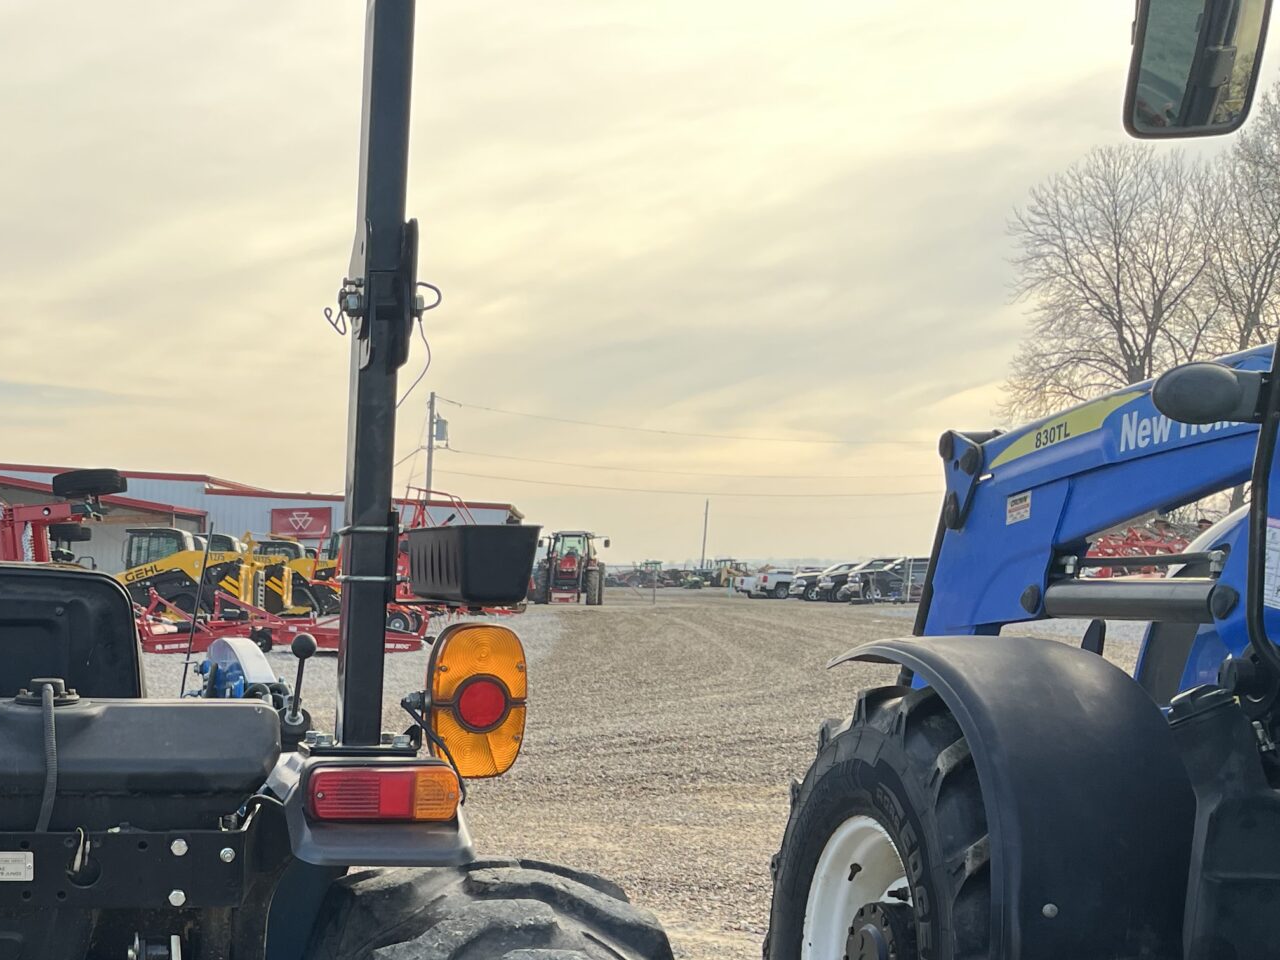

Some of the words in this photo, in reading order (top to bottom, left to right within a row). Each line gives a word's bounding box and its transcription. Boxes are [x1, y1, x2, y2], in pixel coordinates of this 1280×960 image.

[1035, 422, 1070, 449] 830TL
[1120, 411, 1174, 452] New
[125, 564, 164, 583] GEHL
